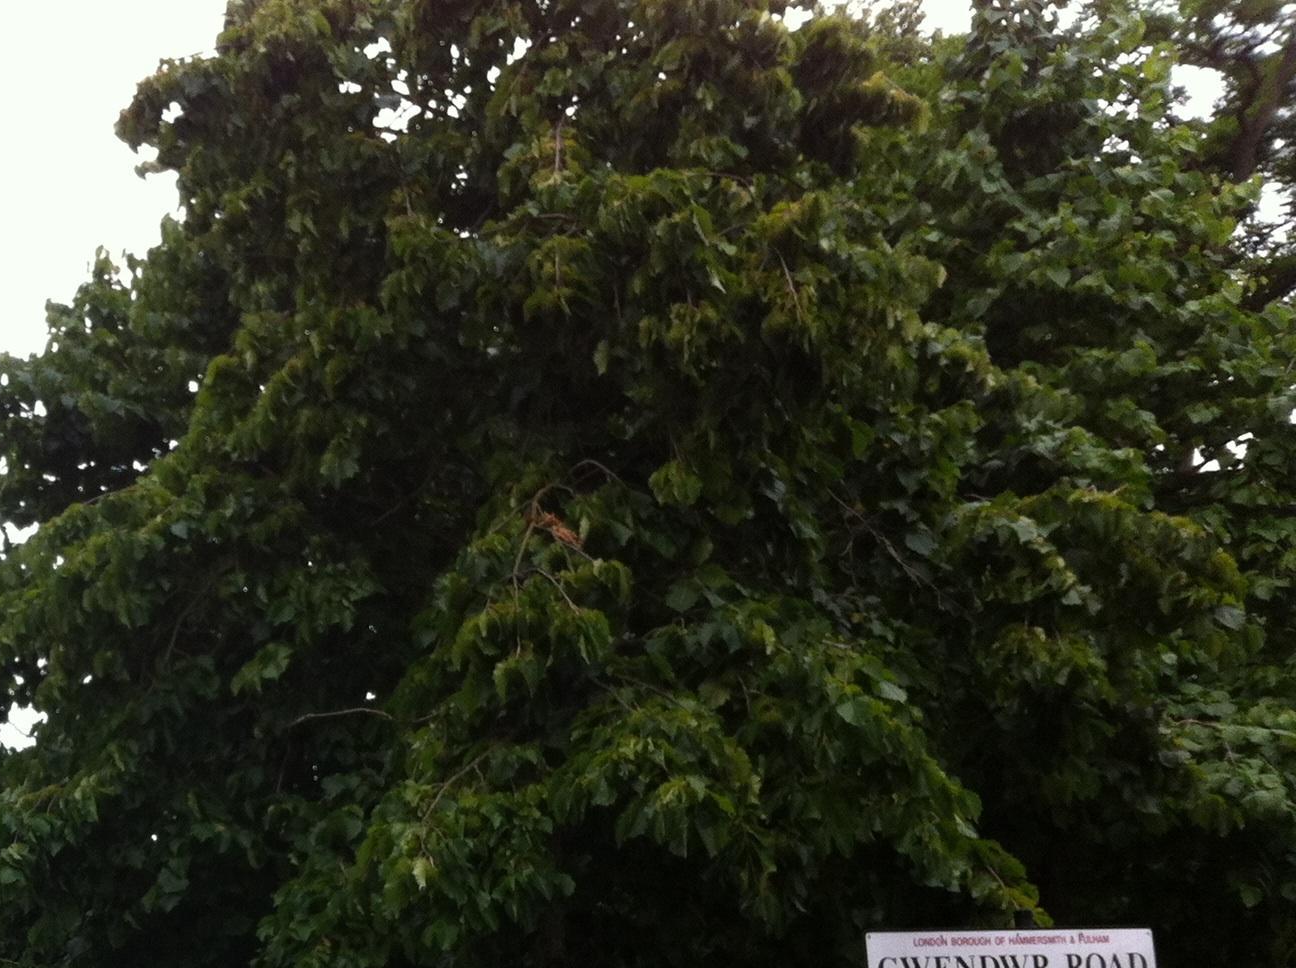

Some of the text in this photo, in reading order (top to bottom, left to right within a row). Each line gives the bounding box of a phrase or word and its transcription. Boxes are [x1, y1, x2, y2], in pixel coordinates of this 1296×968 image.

[913, 937, 947, 947] LONDON
[951, 937, 991, 946] BOROUGH
[994, 936, 1004, 945] OF
[1008, 934, 1066, 945] HAMMERSMITH
[1078, 933, 1110, 944] FULHAM
